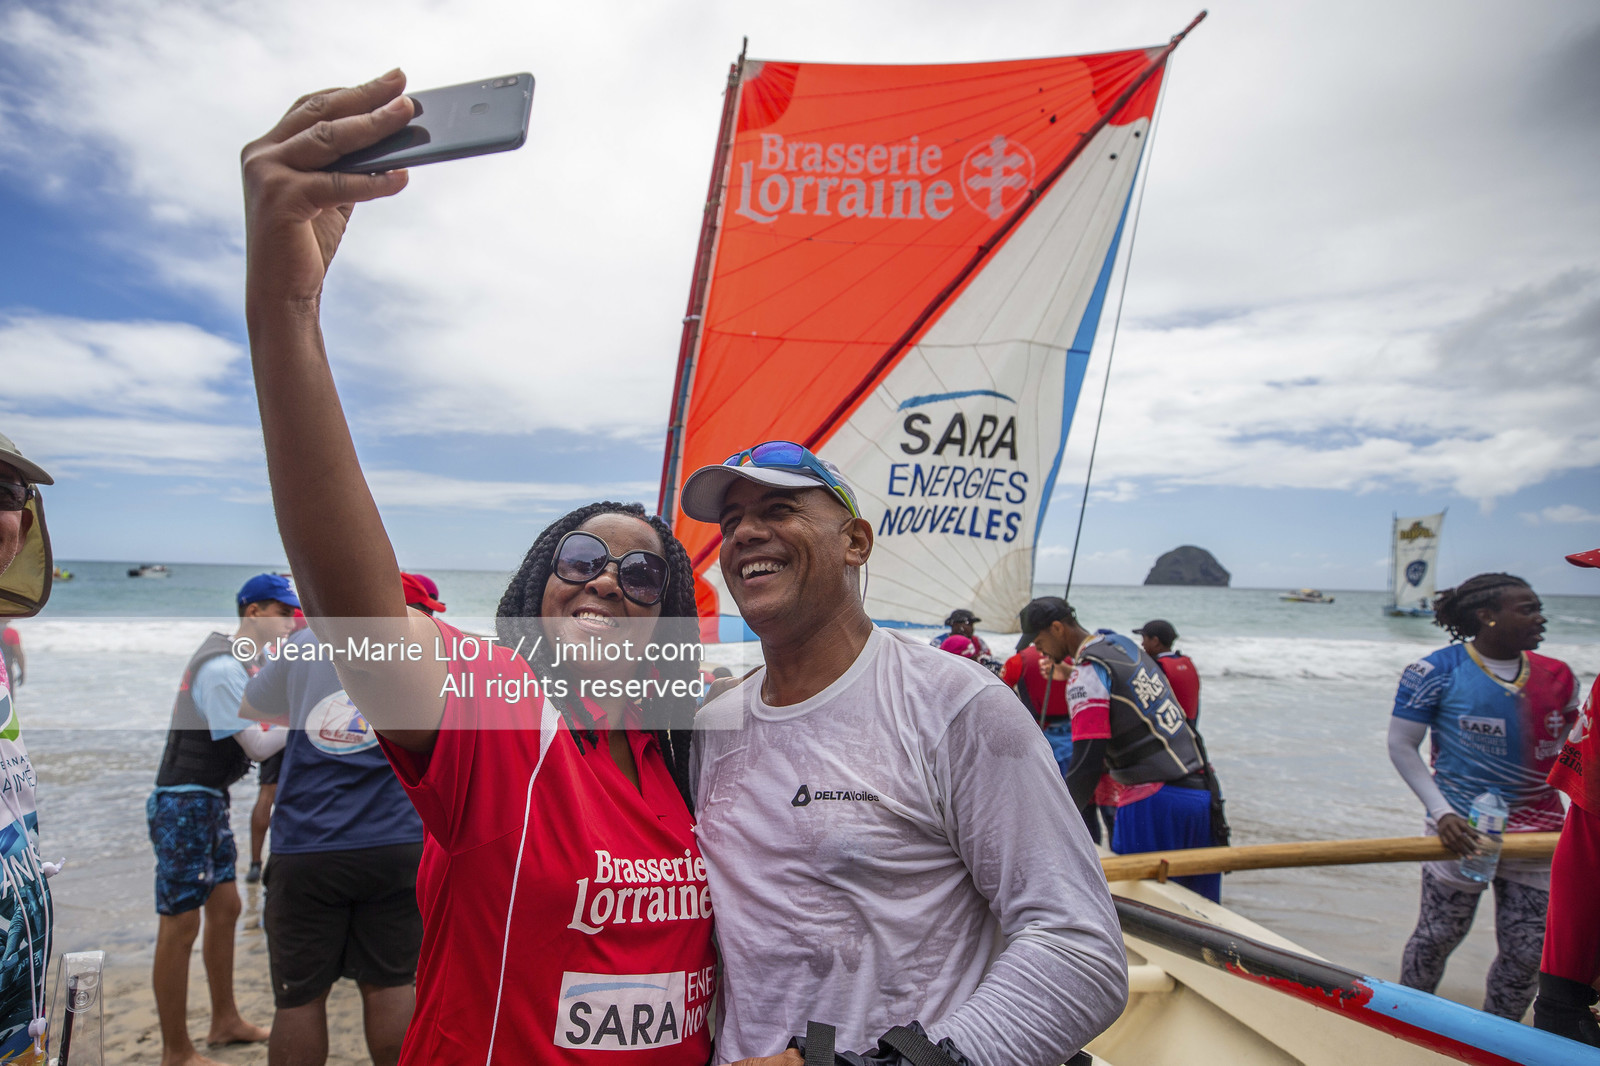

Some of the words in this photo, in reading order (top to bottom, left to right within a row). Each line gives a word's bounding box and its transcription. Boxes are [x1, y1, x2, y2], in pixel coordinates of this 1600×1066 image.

[758, 132, 943, 176] Brasserie
[735, 159, 954, 224] Lorraine
[900, 412, 1018, 461] SARA
[888, 463, 1029, 505] ENERGIES
[878, 504, 1022, 543] NOUVELLES
[1461, 720, 1503, 735] SARA
[594, 848, 707, 884] Brasserie
[567, 877, 714, 935] Lorraine
[565, 1001, 679, 1046] SARA
